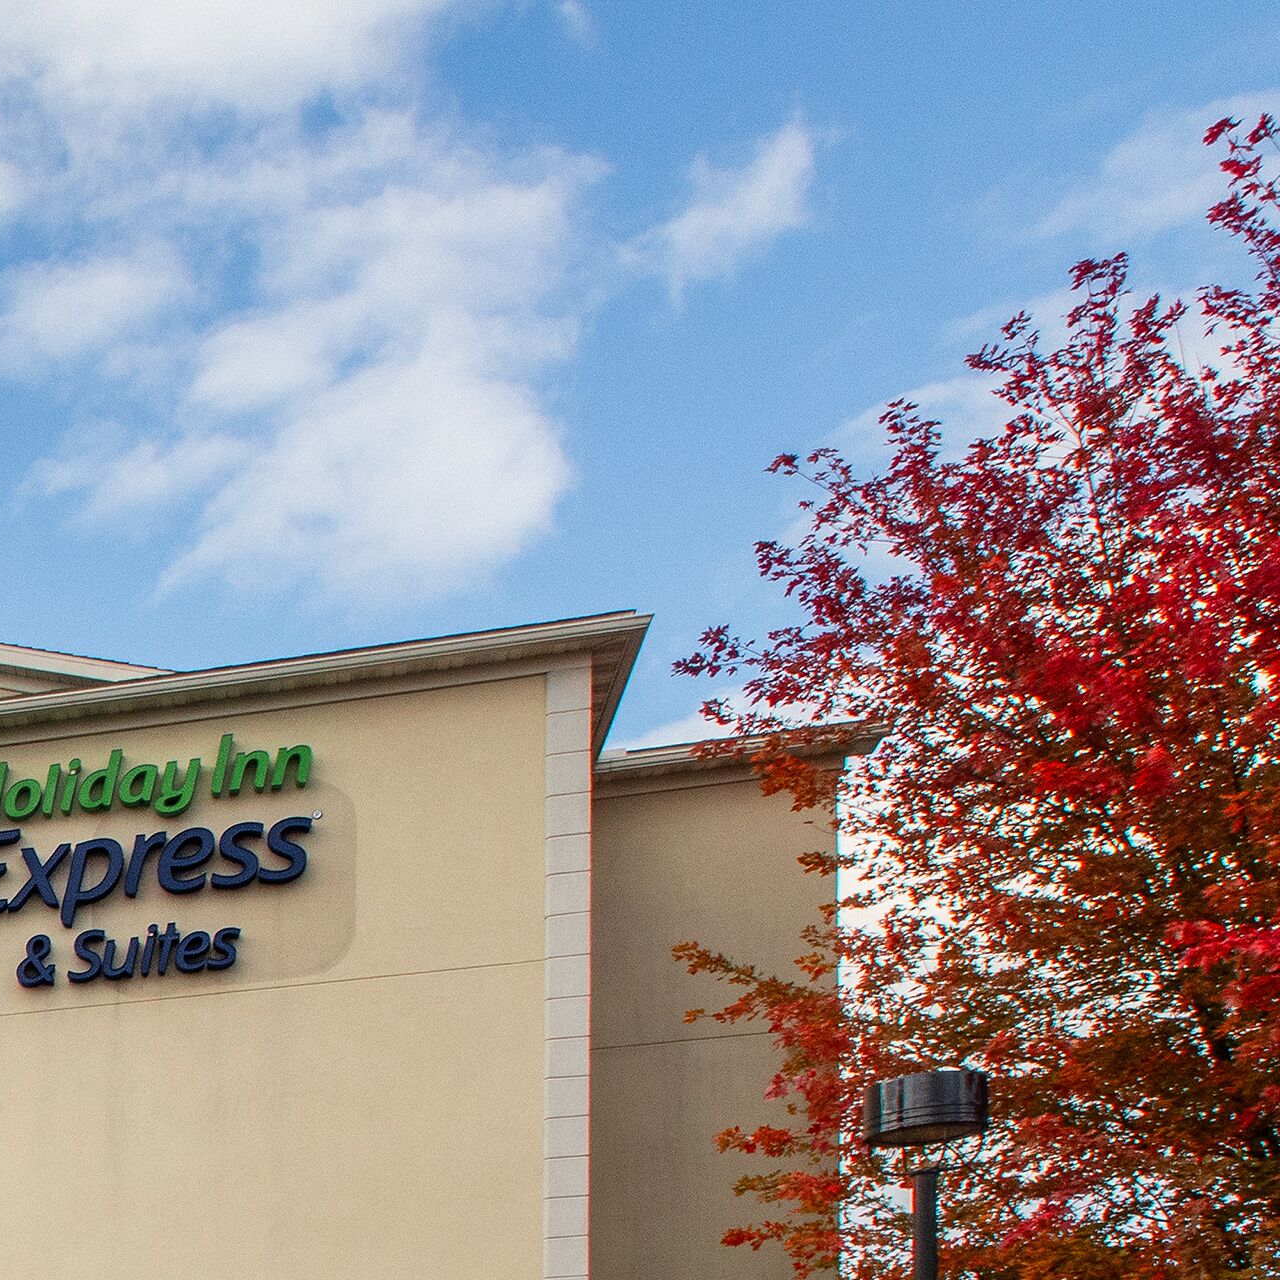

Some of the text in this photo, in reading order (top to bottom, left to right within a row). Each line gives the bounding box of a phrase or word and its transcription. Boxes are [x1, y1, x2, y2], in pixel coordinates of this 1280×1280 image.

[212, 733, 313, 797] Inn
[16, 922, 241, 988] & Suites
